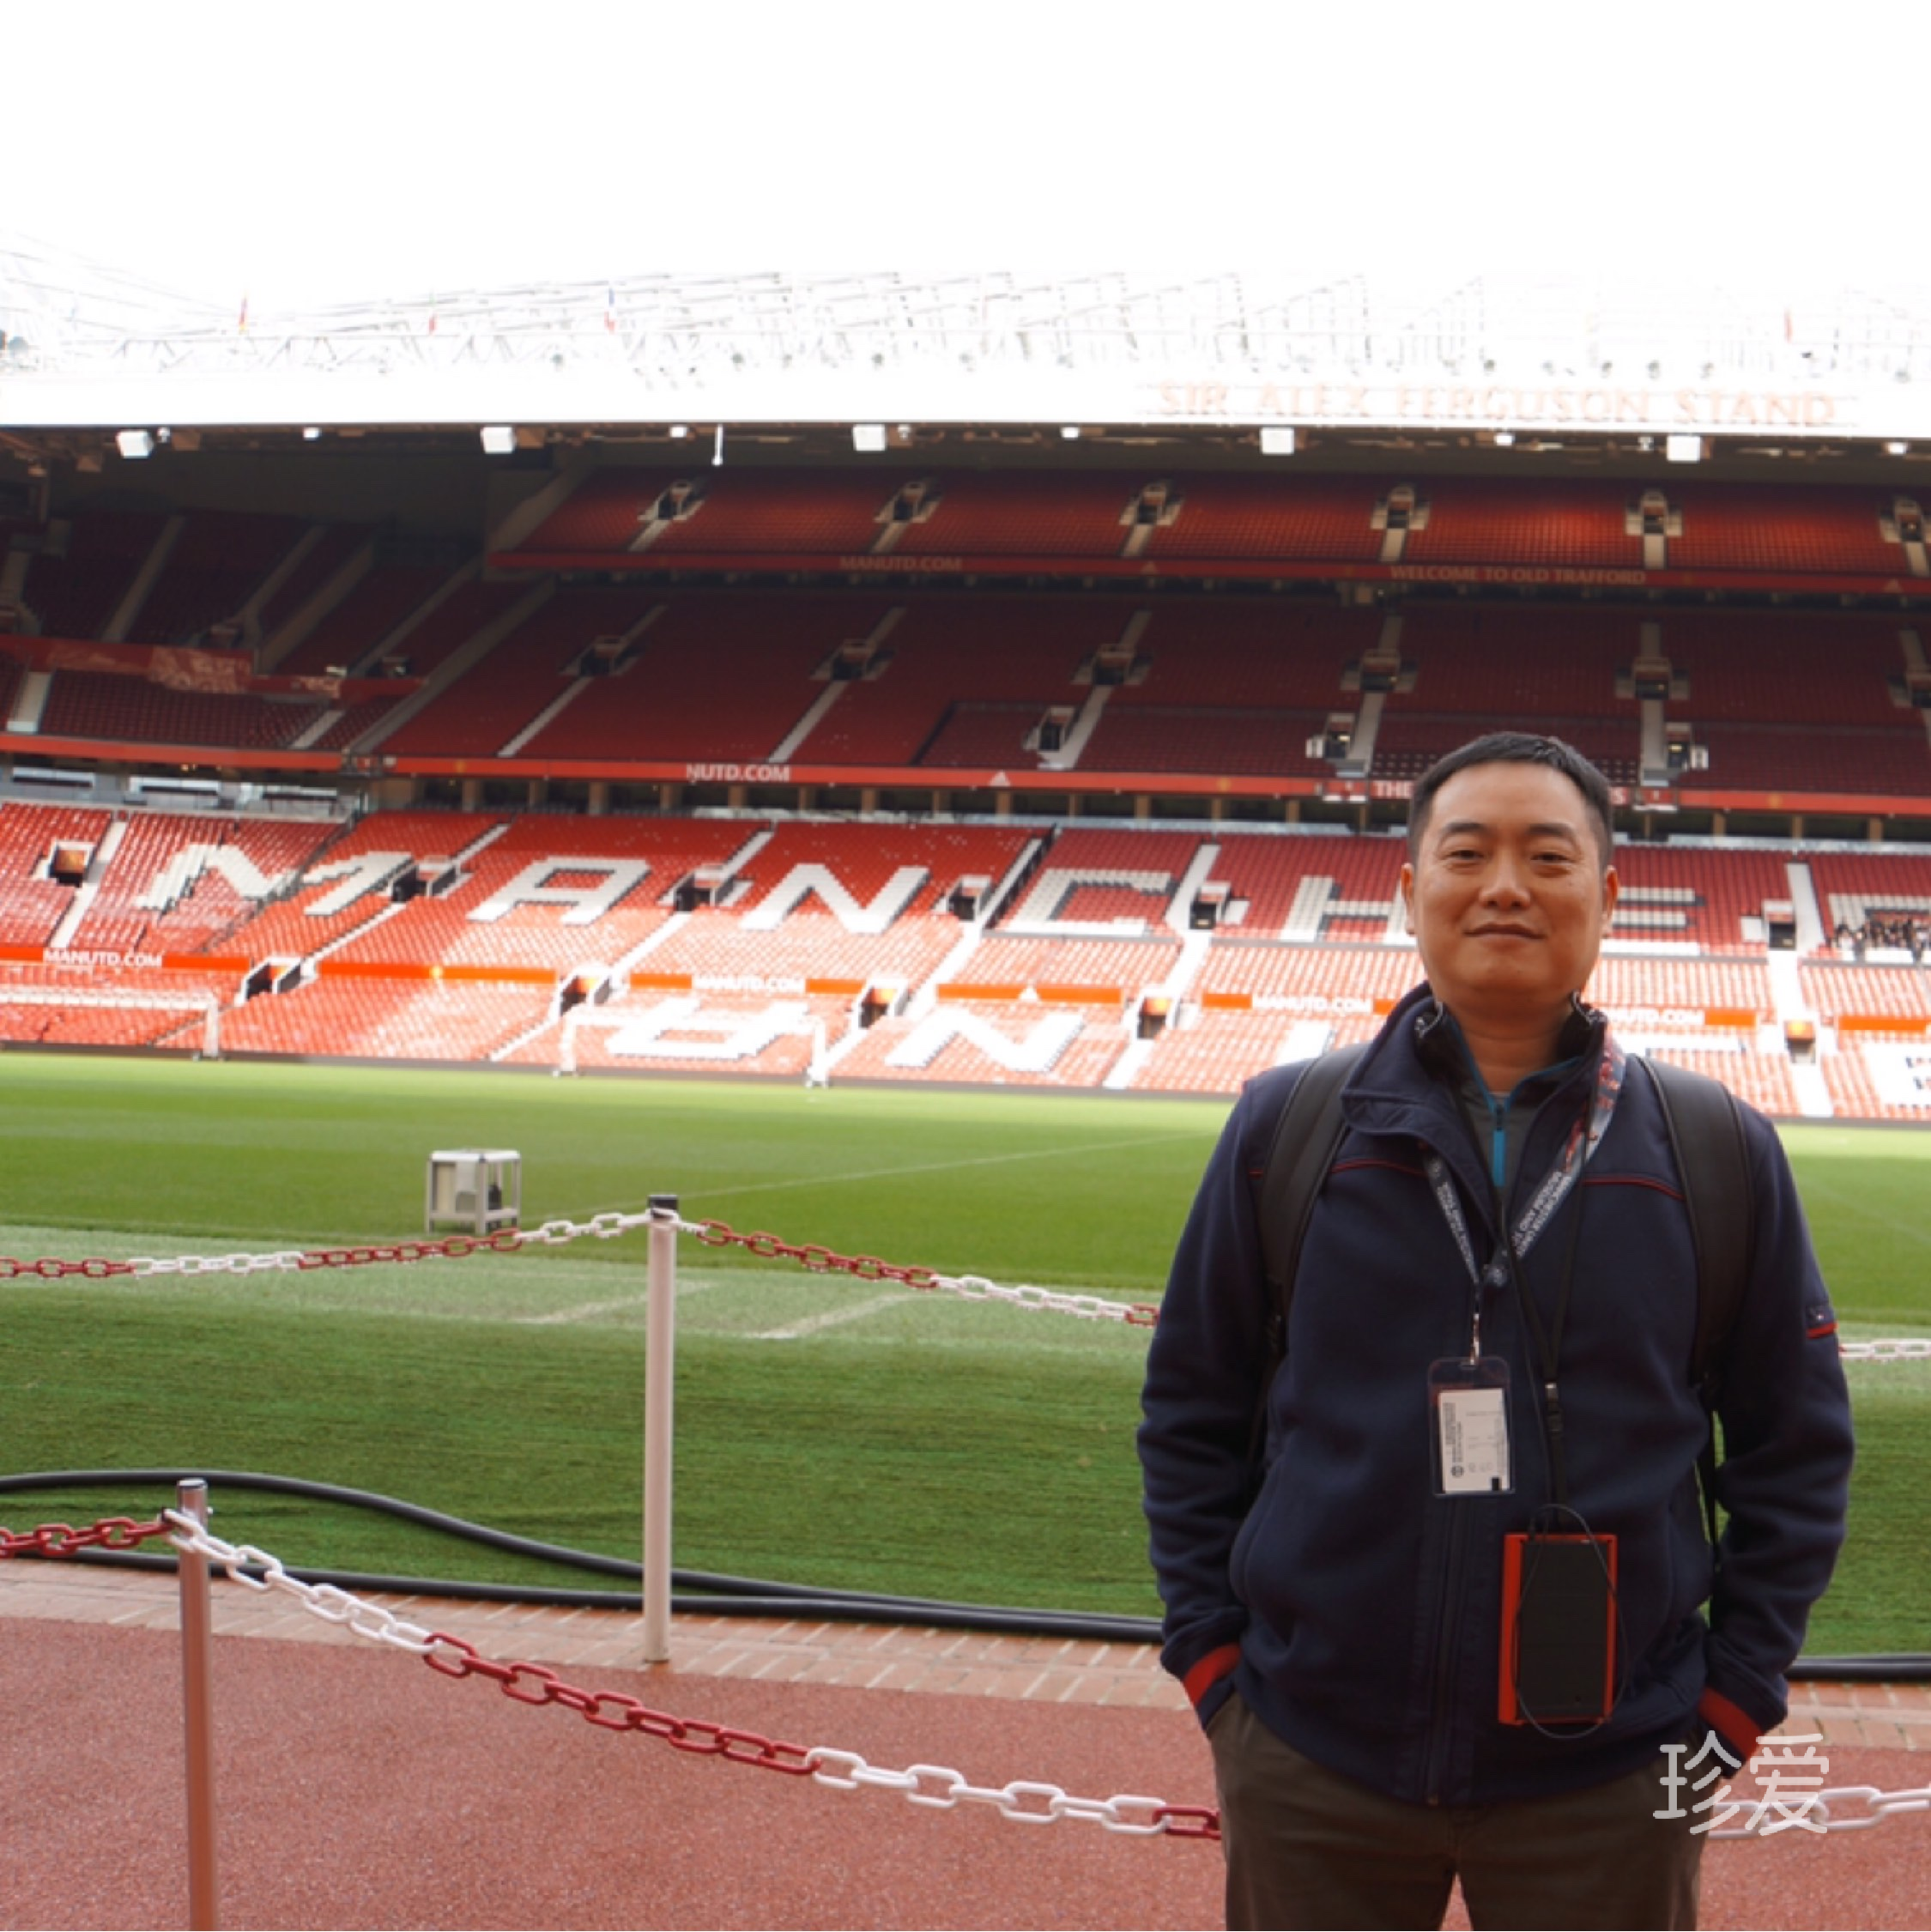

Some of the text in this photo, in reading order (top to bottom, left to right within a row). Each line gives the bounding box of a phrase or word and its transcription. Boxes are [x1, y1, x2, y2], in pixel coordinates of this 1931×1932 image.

[1158, 381, 1836, 427] SIR ALEX FERGUSON STAND
[1390, 565, 1646, 585] WELCOME TO OLD TRAFFORD
